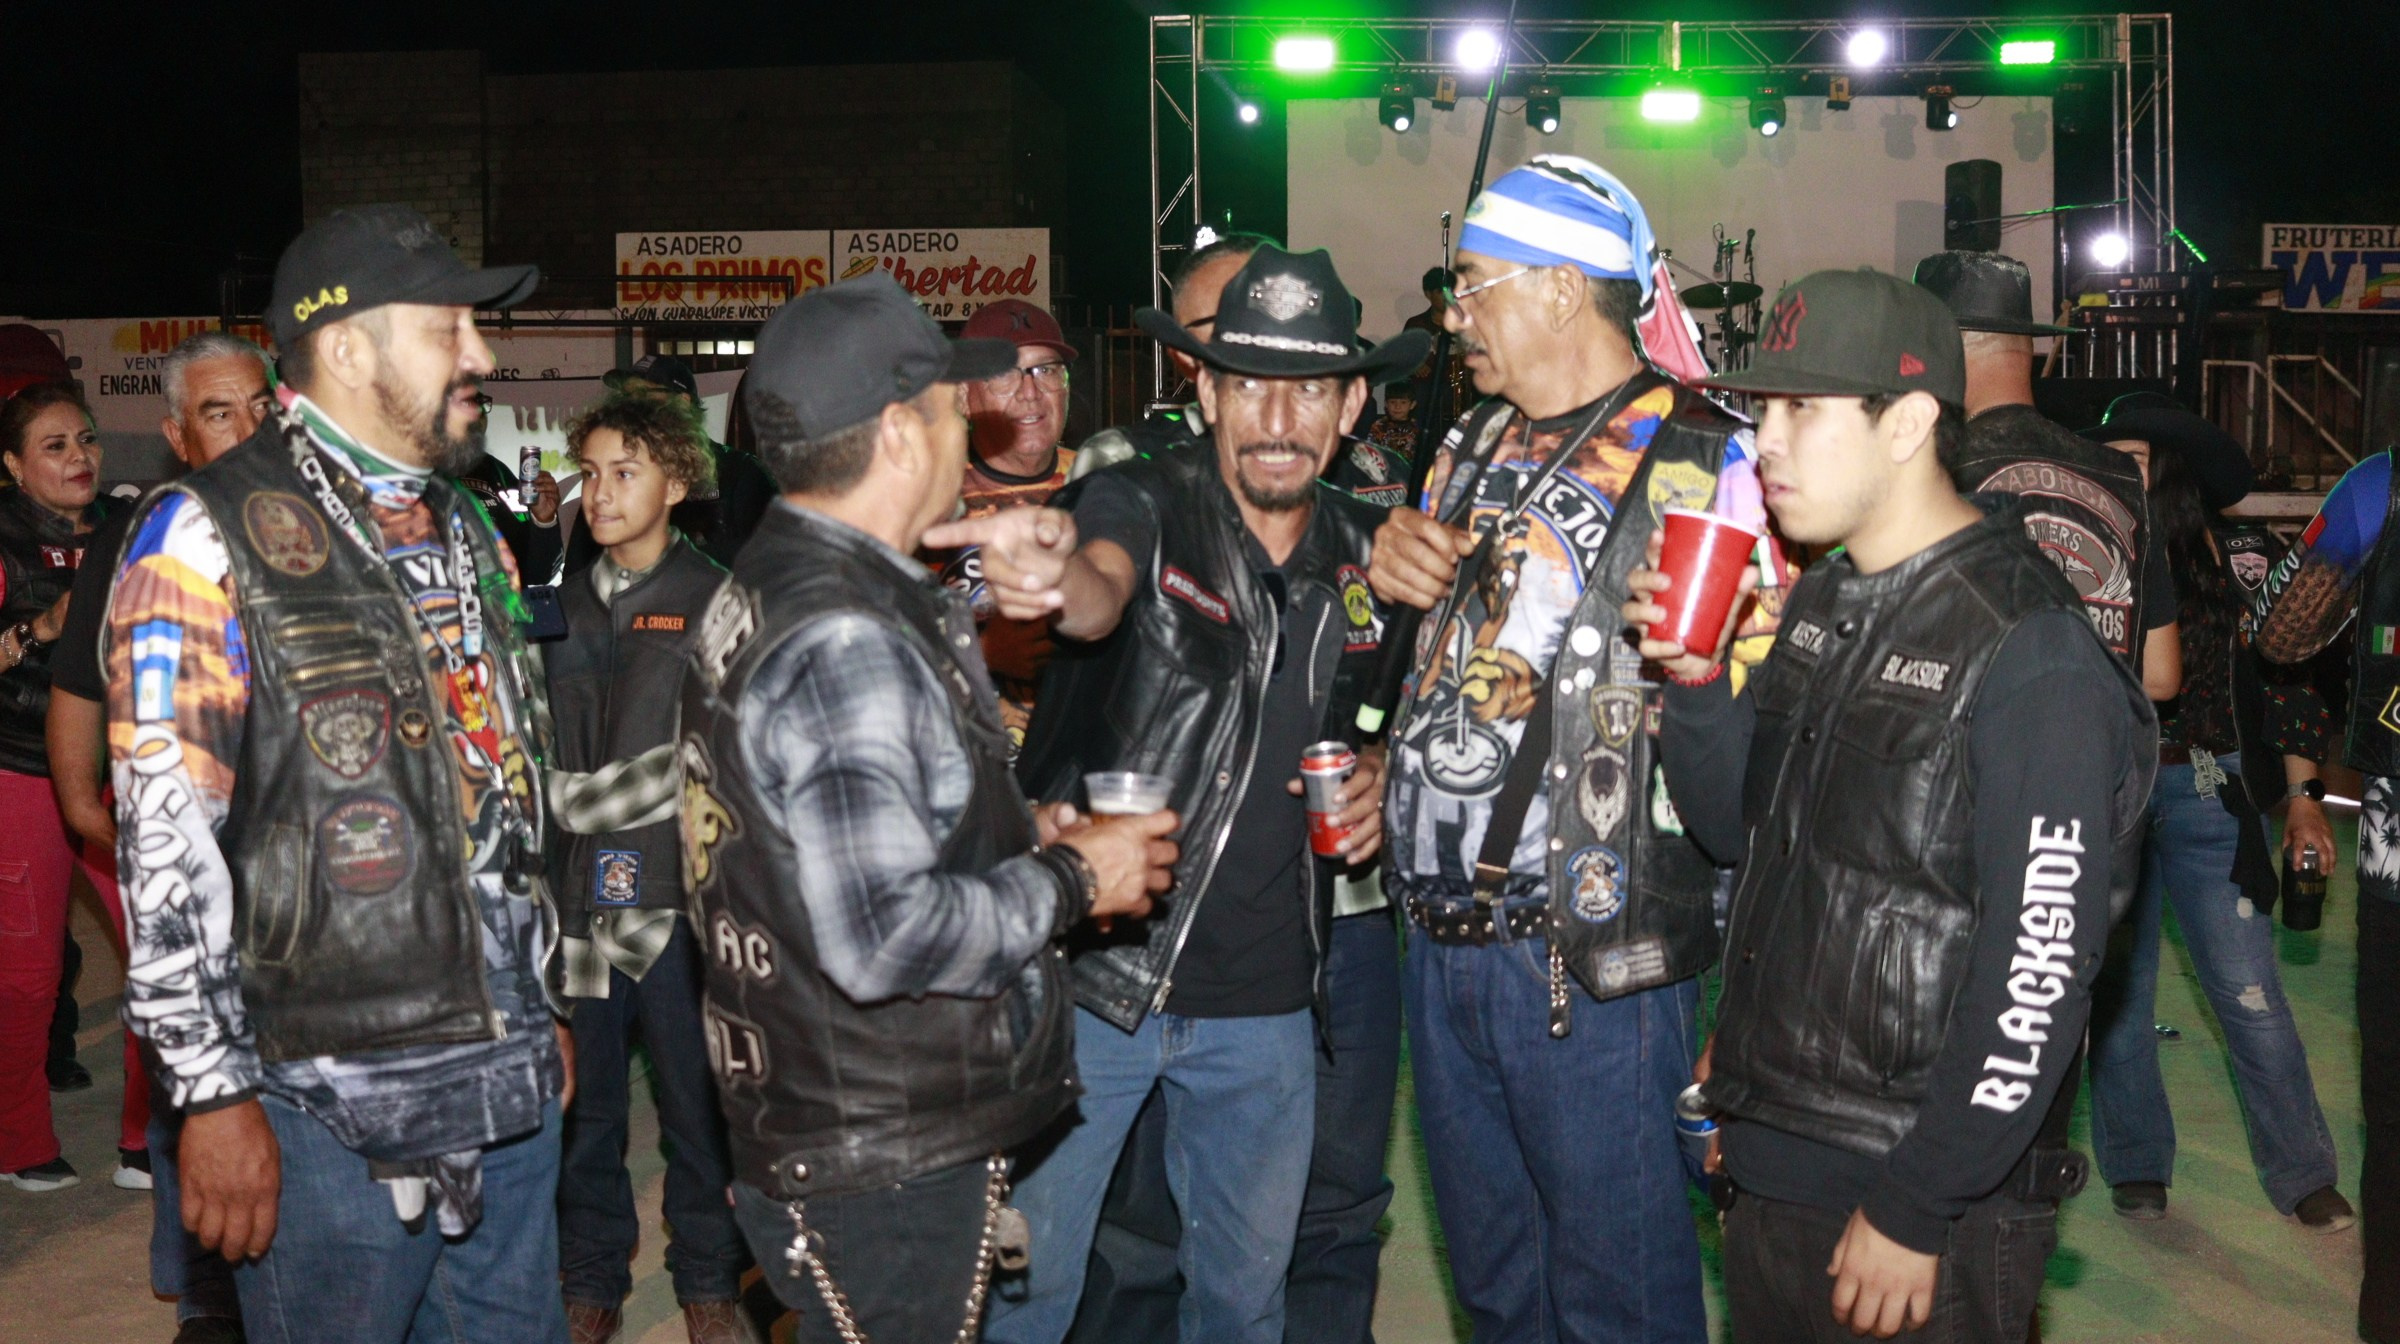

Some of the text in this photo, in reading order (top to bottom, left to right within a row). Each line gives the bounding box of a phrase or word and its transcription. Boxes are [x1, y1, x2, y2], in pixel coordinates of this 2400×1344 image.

[637, 235, 743, 256] ASADERO
[848, 232, 960, 253] ASADERO
[2271, 225, 2400, 248] FRUTERÍ
[621, 257, 826, 301] LOS PRIMOS
[883, 254, 1038, 297] bertad
[2270, 250, 2400, 309] WE
[293, 285, 349, 323] OLAS
[662, 305, 738, 320] GUADALUPE
[124, 357, 165, 371] VENT
[100, 374, 162, 396] ENGRAN
[2028, 523, 2083, 552] BIKERS
[648, 615, 685, 631] CROCKER
[1970, 815, 2086, 1113] BLACKSIDE
